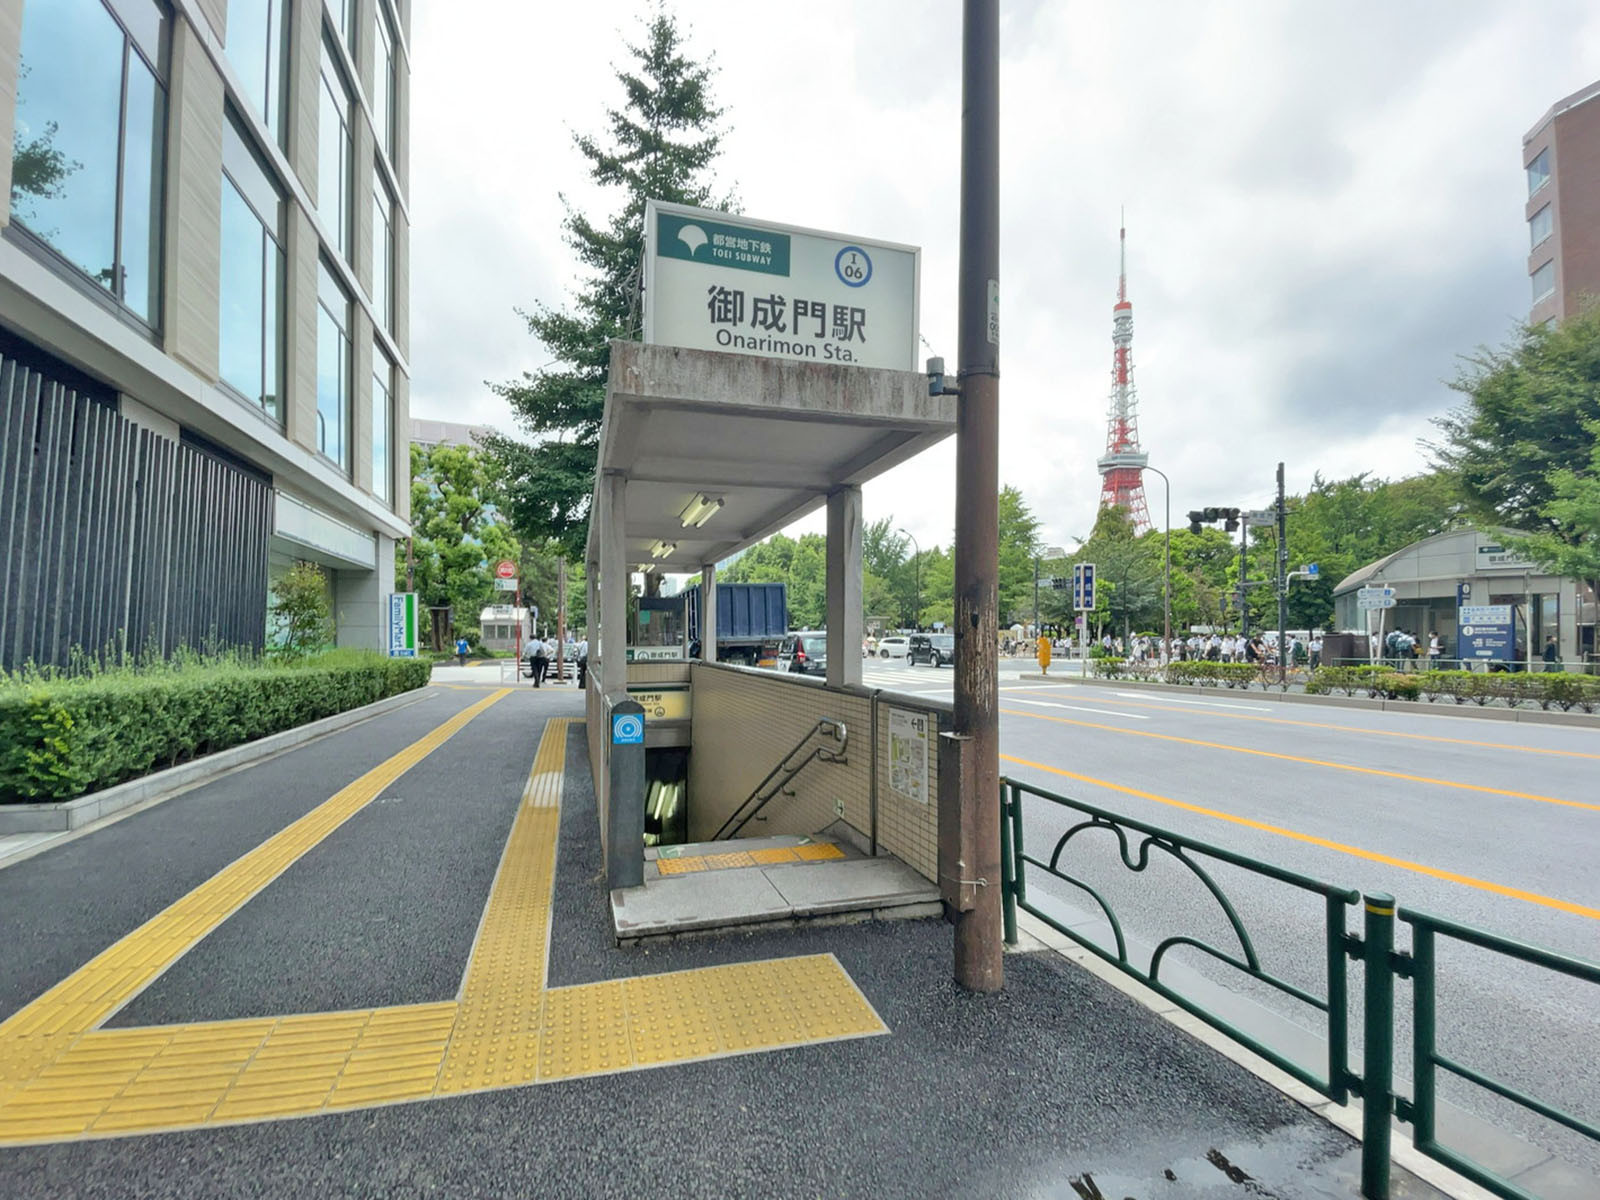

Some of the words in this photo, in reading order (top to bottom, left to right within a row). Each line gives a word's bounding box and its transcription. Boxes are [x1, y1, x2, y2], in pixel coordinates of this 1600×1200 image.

[712, 233, 772, 255] 都営地下鉄
[712, 247, 733, 260] TOEI
[735, 250, 772, 266] SUBWAY
[850, 253, 858, 265] I
[844, 264, 863, 280] 06
[707, 285, 867, 344] 御成門駅
[716, 328, 817, 358] Onarimon
[823, 342, 859, 363] Sta.
[393, 597, 404, 649] FamilyMart
